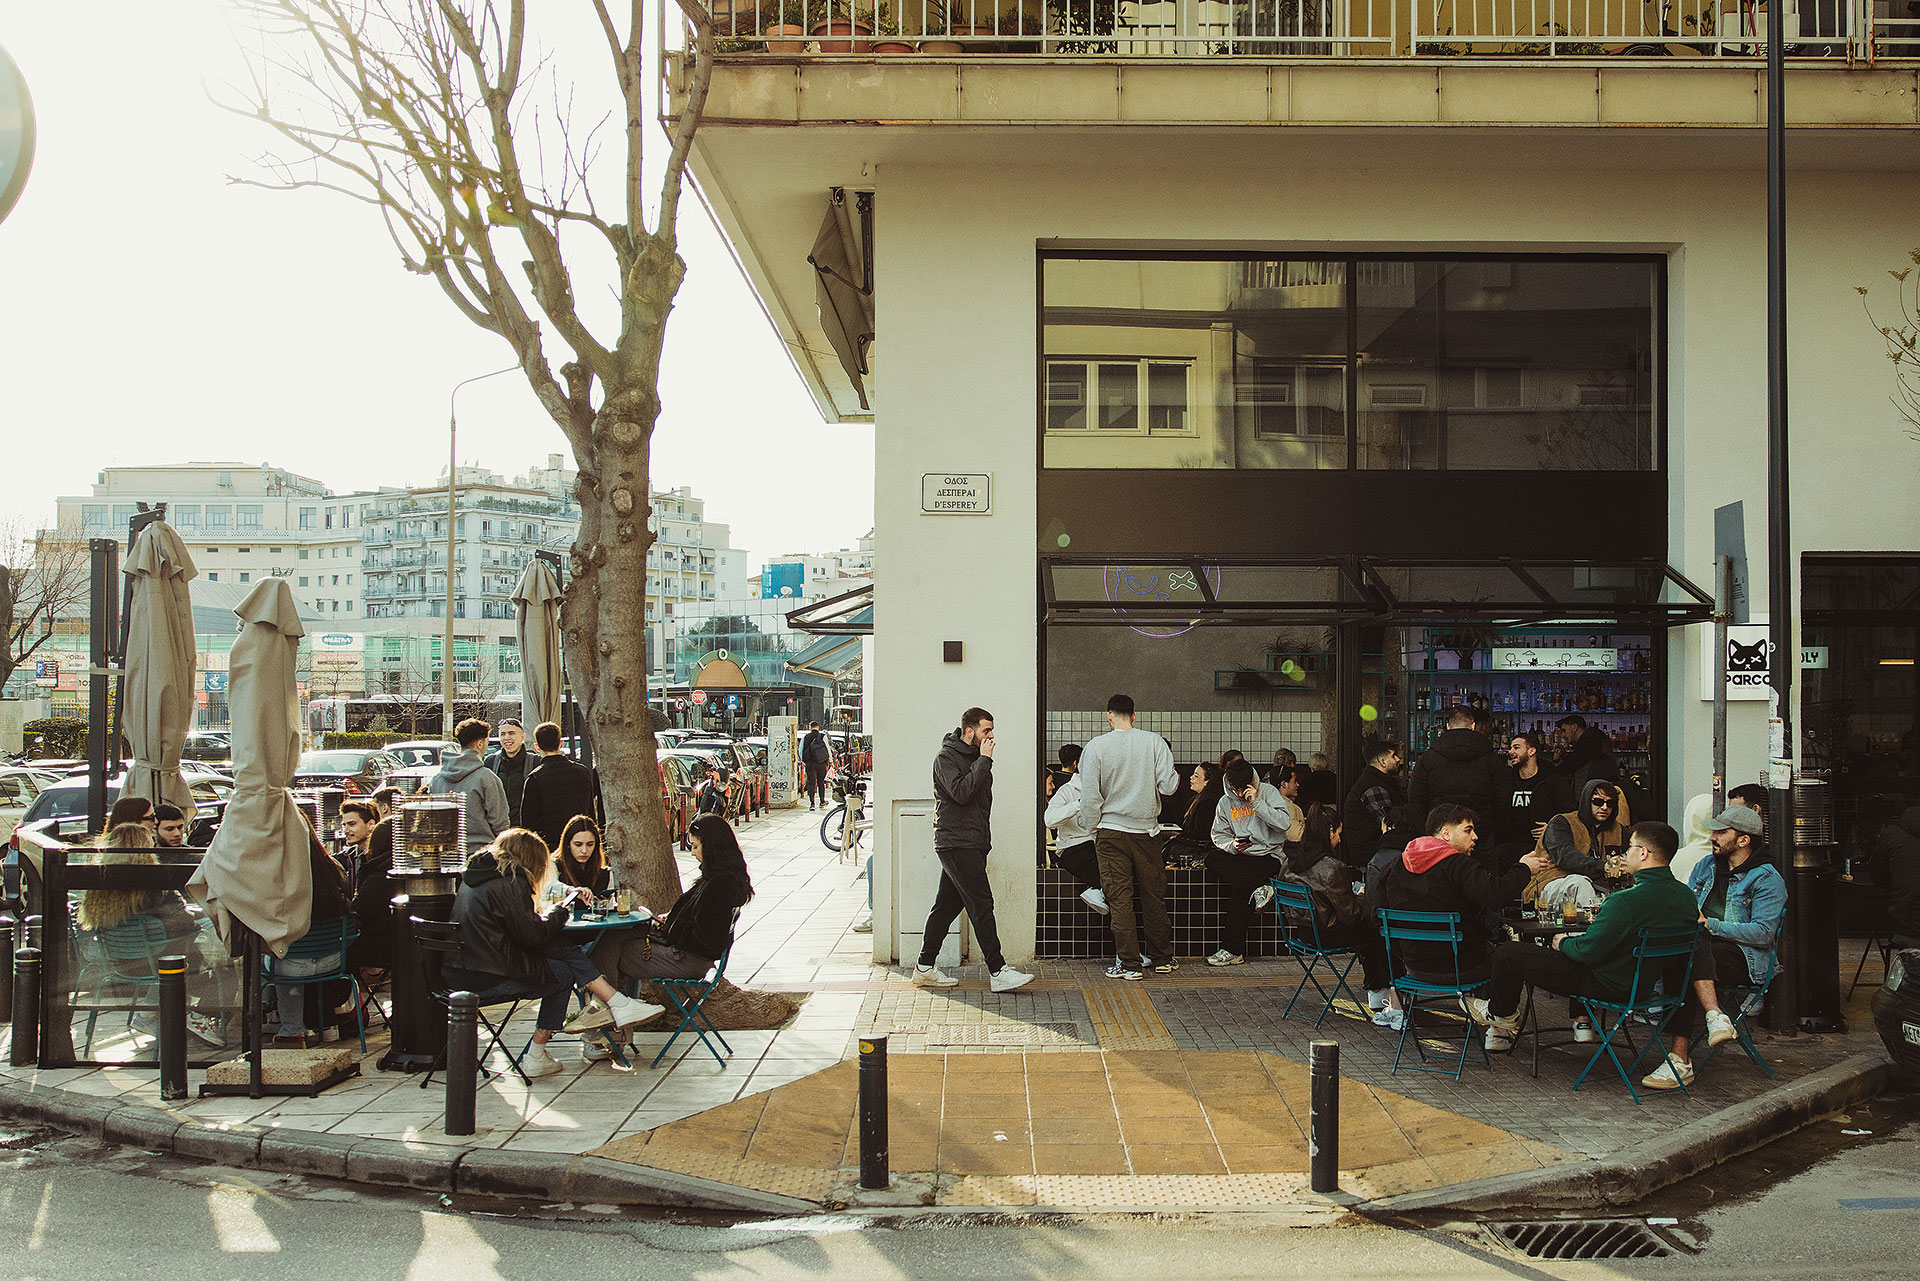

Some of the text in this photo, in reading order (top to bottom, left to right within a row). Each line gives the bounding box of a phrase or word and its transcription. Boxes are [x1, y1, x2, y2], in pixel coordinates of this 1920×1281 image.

[944, 477, 968, 485] ΟΔΟΣ
[936, 489, 976, 497] ΔΕΣΠΕΡΑΙ
[934, 500, 978, 509] D'ESPEREY
[729, 695, 736, 704] P
